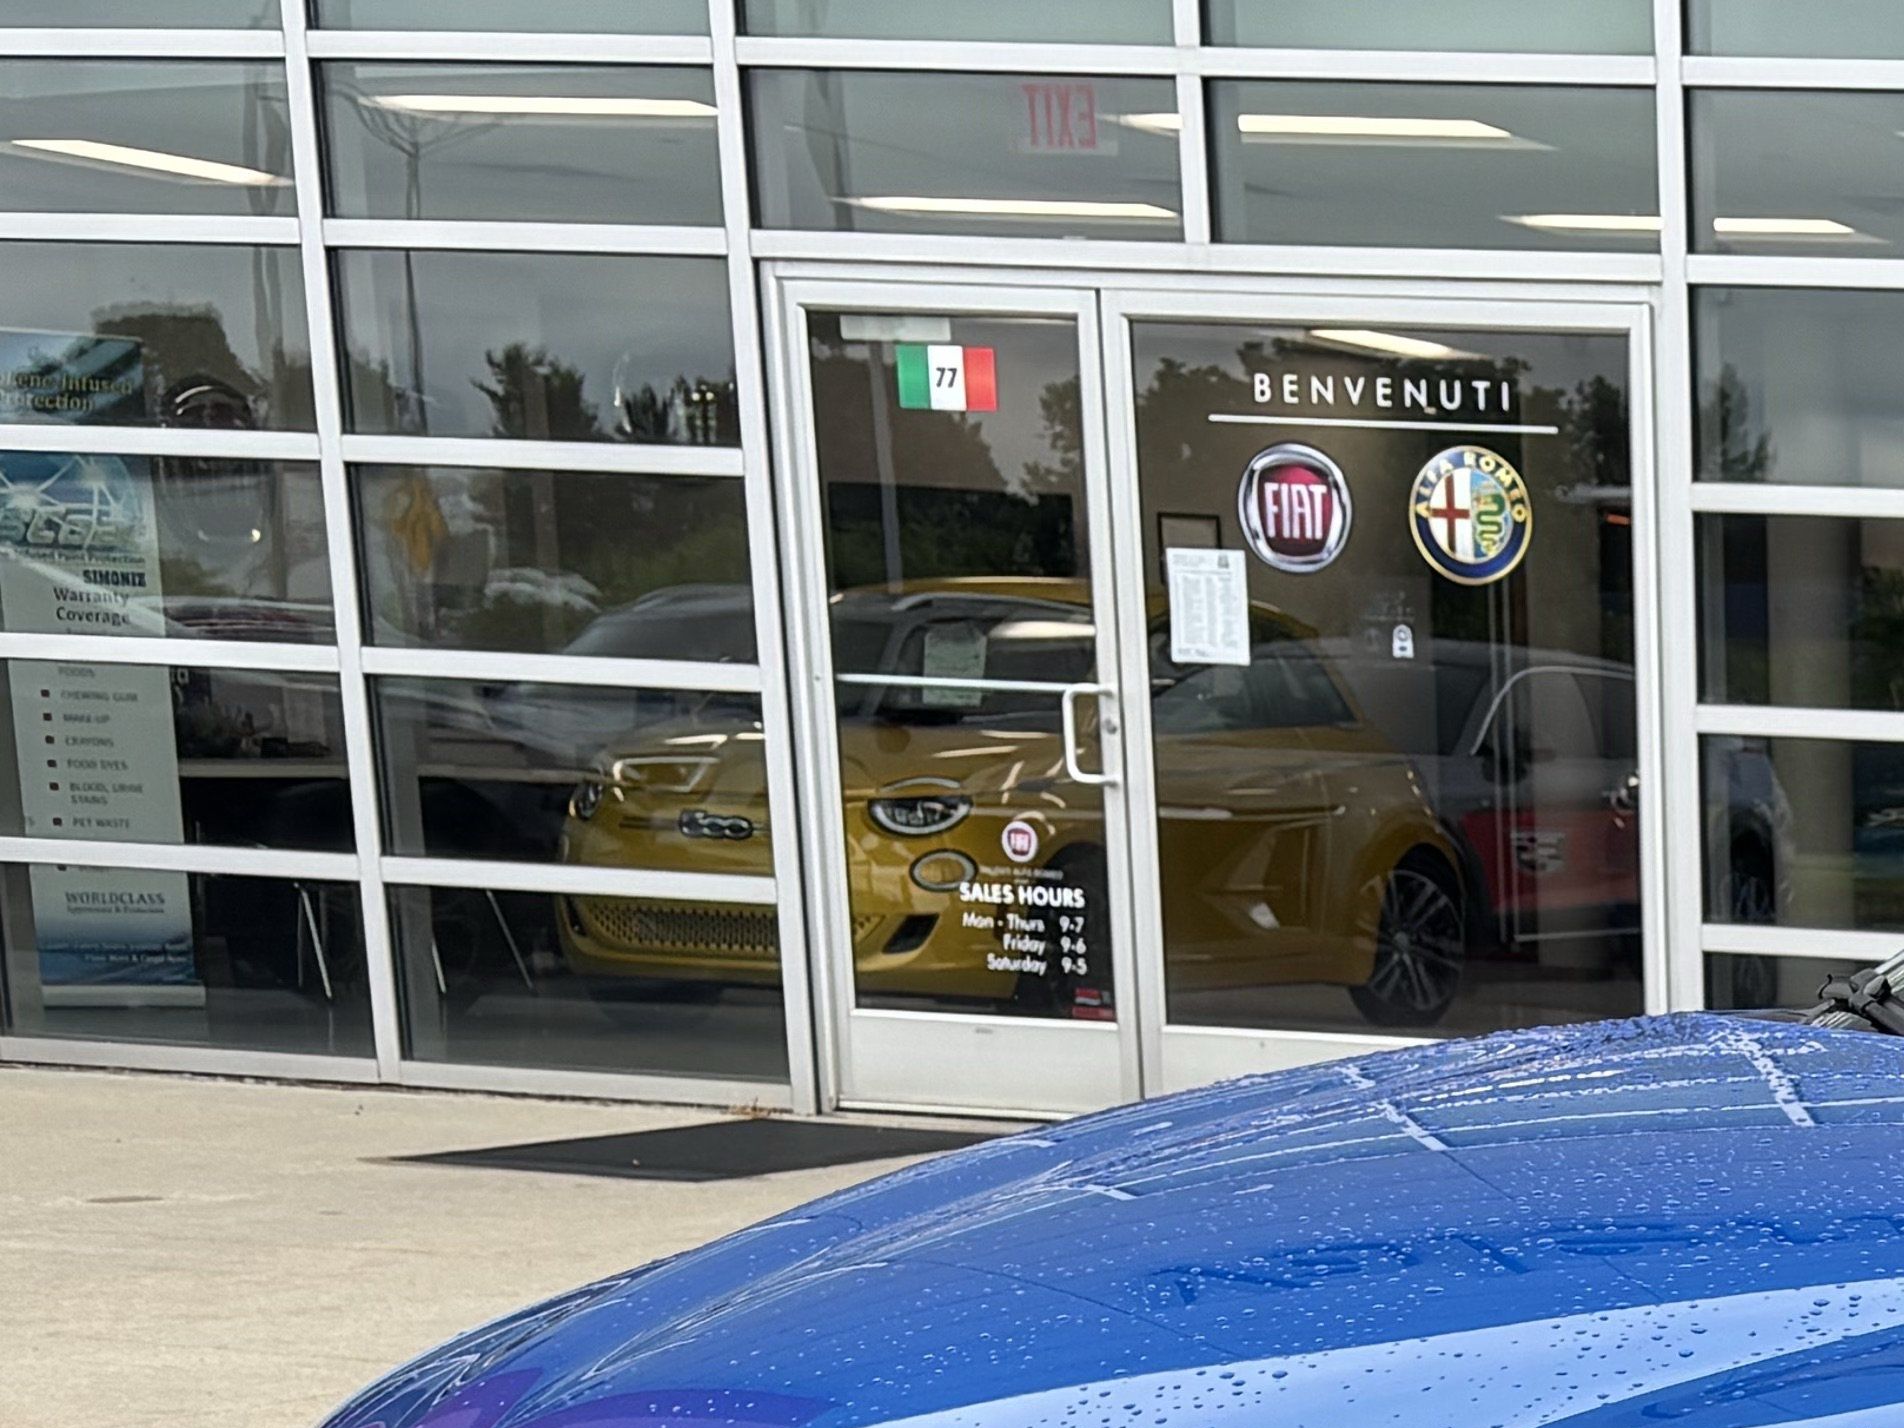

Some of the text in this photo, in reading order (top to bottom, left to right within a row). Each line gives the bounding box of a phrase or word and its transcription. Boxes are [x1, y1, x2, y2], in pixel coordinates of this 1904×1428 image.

[936, 367, 958, 388] 77
[1253, 373, 1510, 412] BENVENUTI
[1415, 451, 1527, 523] ALFA ROMEO
[1264, 482, 1328, 540] FIAT
[83, 569, 147, 587] SIMONIZ
[56, 606, 131, 626] Coverage
[65, 891, 165, 905] WORLDCLASS
[959, 882, 1086, 908] SALES HOURS
[962, 911, 994, 928] Mon
[1006, 913, 1045, 933] Thurs
[1003, 933, 1087, 956] Friday 9-6
[986, 953, 1088, 976] Saturday 9-5
